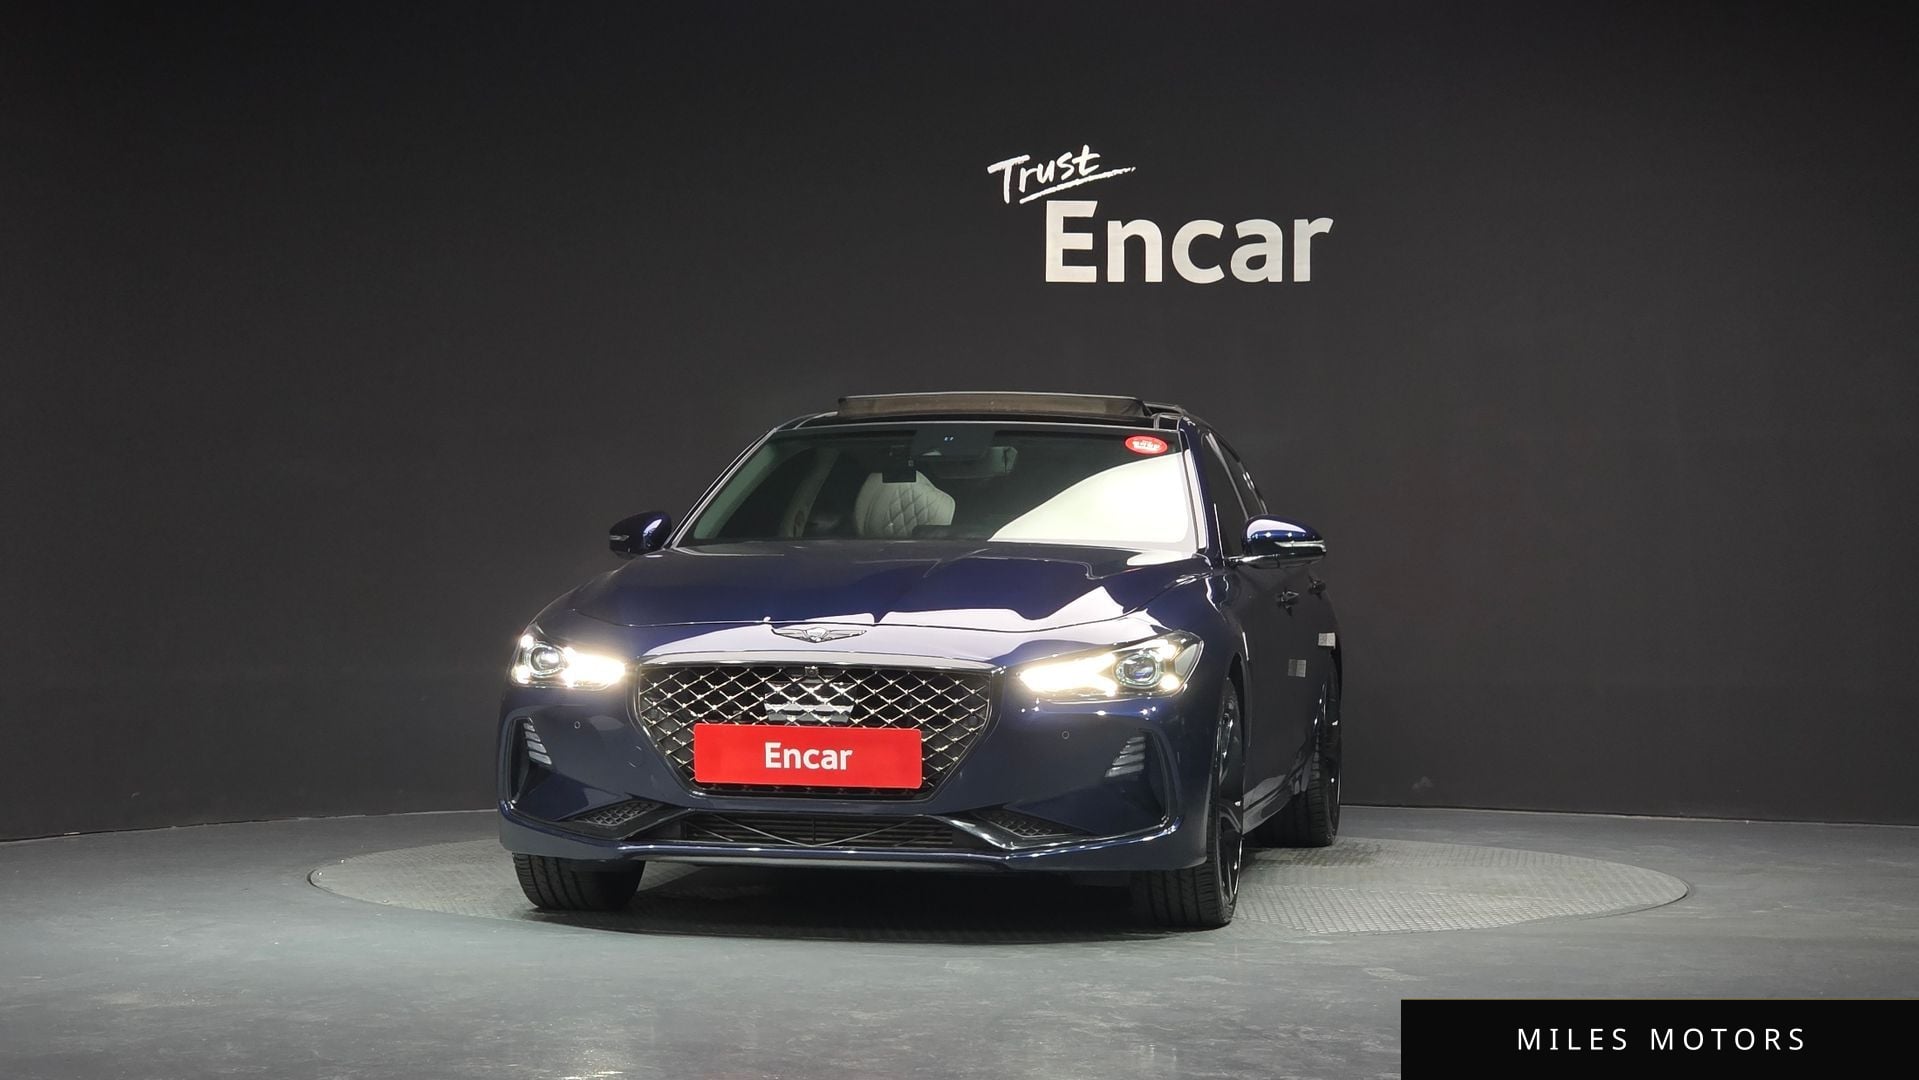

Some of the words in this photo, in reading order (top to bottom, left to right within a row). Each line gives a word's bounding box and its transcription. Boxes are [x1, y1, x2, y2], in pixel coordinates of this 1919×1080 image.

[987, 145, 1101, 204] Trust
[1045, 200, 1334, 283] Encar
[764, 741, 853, 770] Encar
